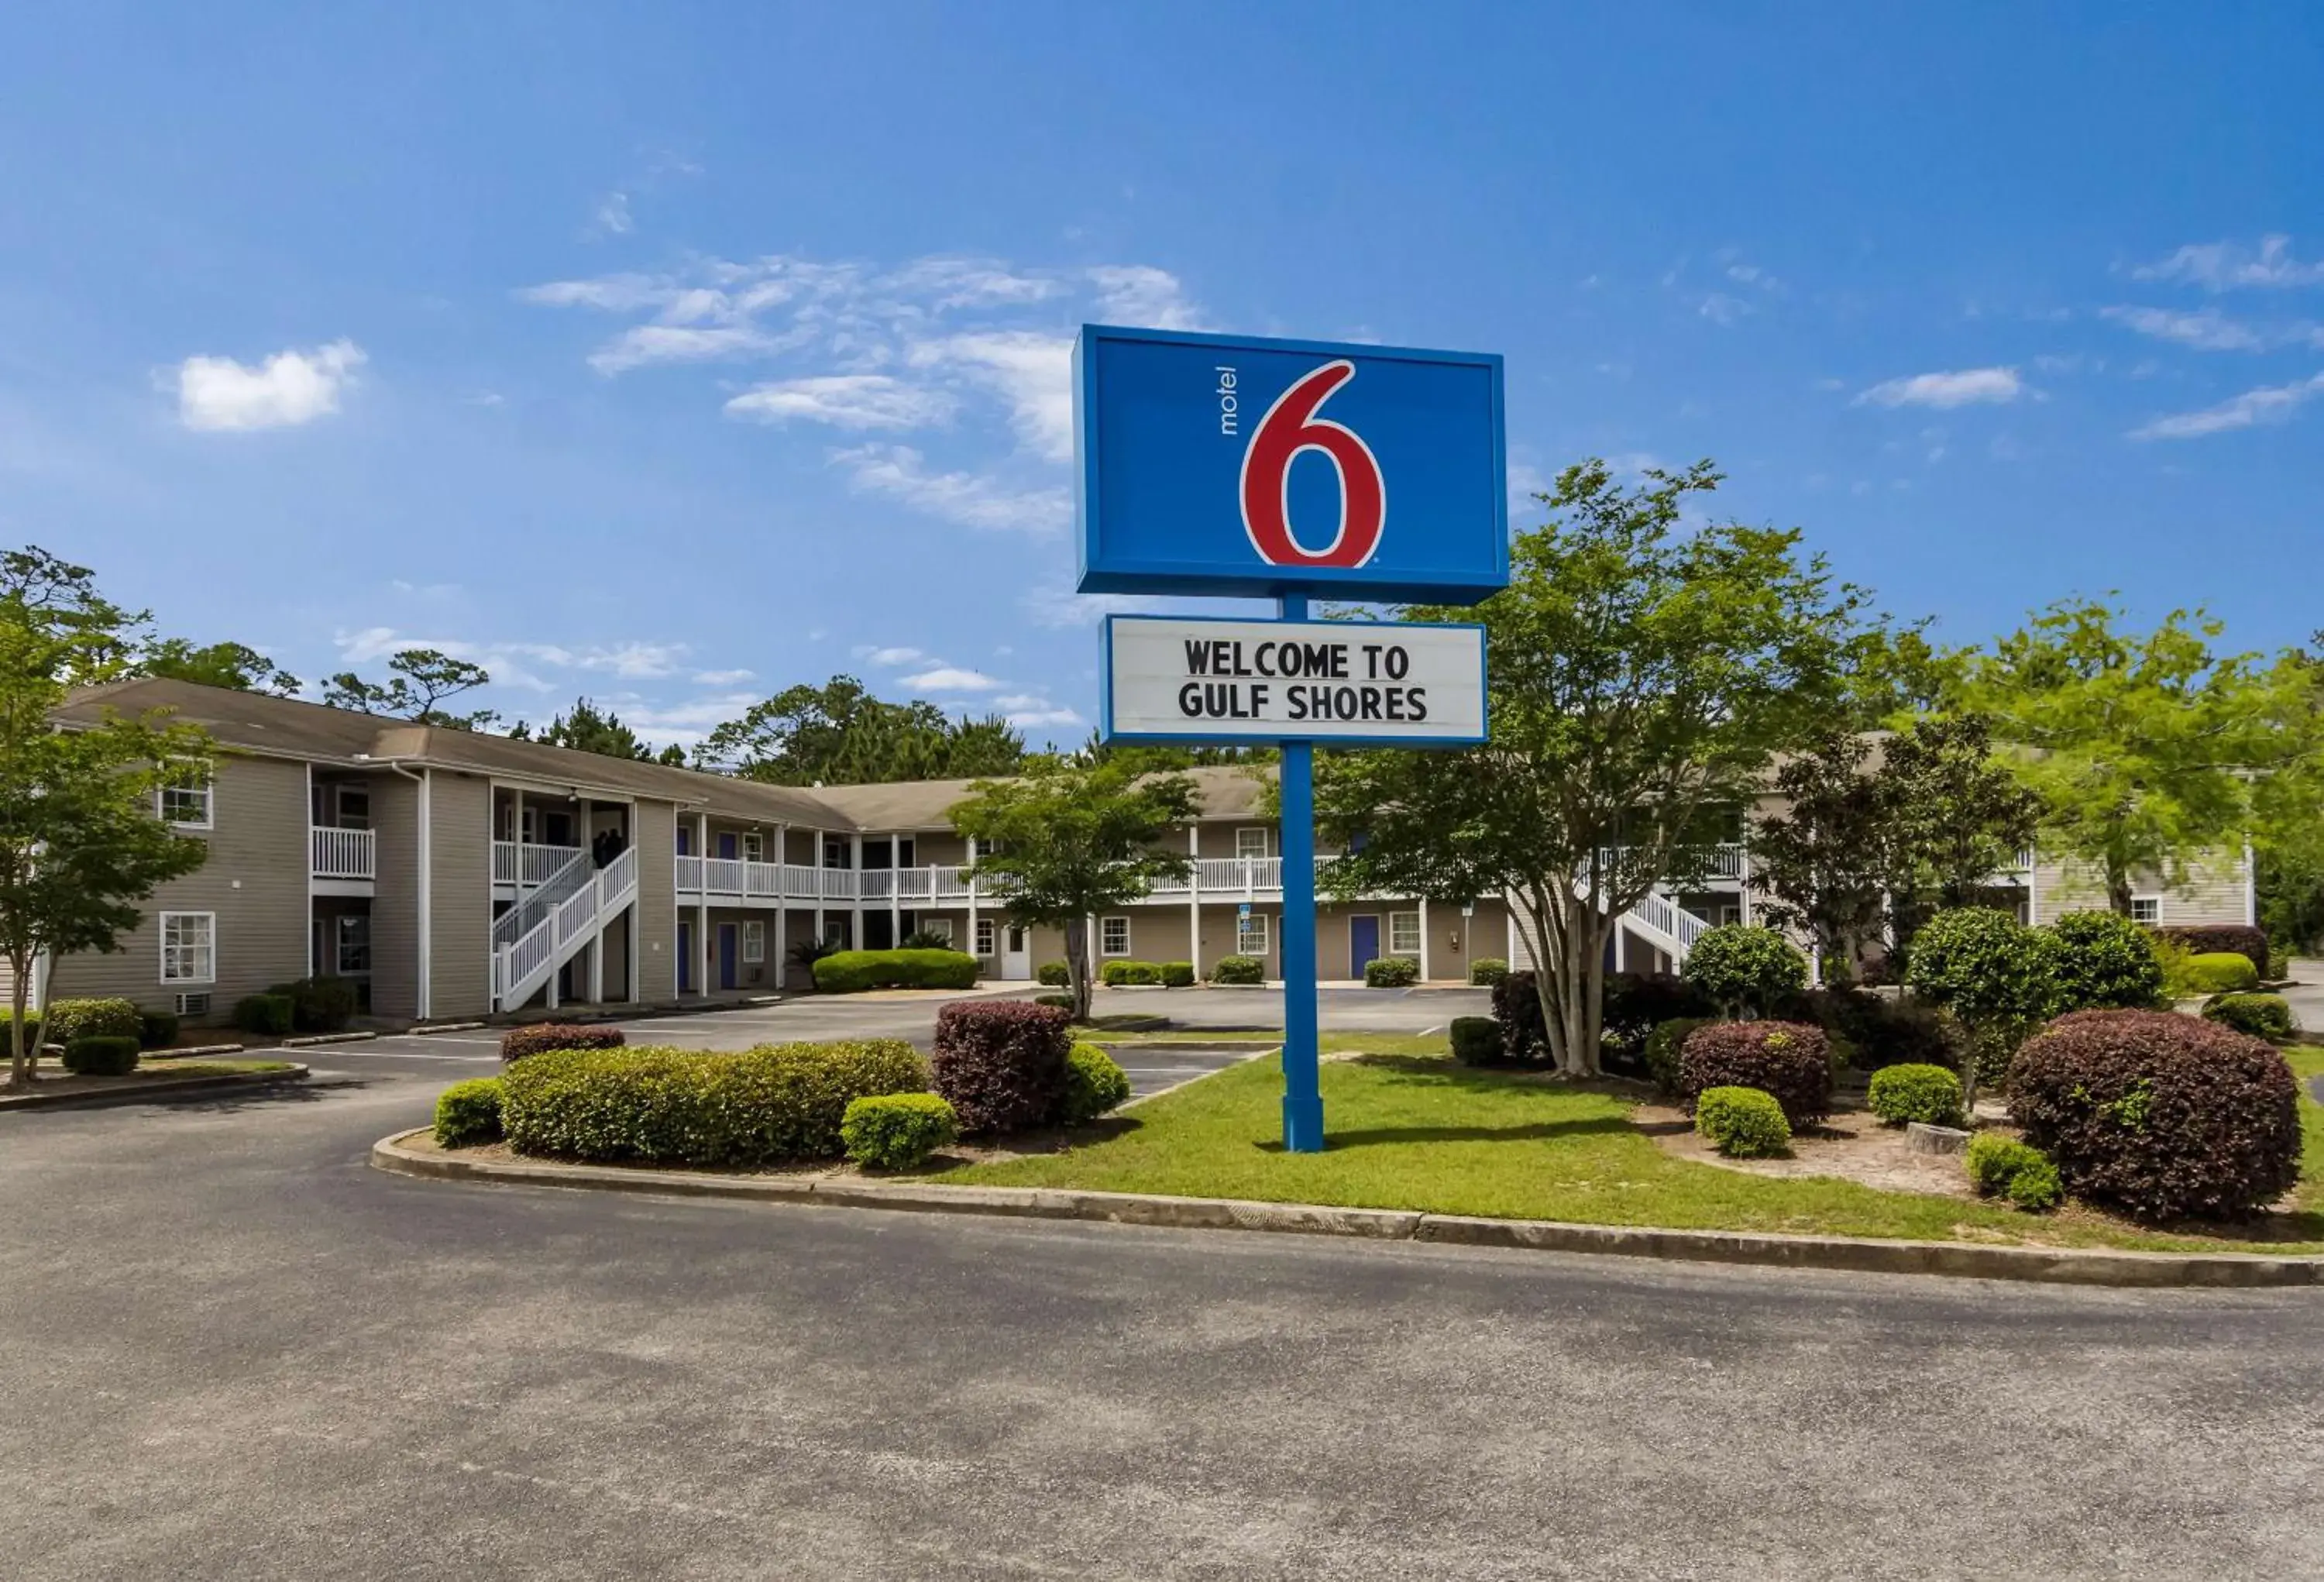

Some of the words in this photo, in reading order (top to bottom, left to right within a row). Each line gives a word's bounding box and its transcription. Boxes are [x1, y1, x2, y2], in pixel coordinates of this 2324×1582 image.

[1215, 366, 1236, 435] motel
[1239, 359, 1387, 569] 6
[1184, 640, 1349, 678] WELCOME
[1362, 645, 1409, 679] TO
[1179, 683, 1269, 717] GULF
[1287, 685, 1428, 720] SHORES
